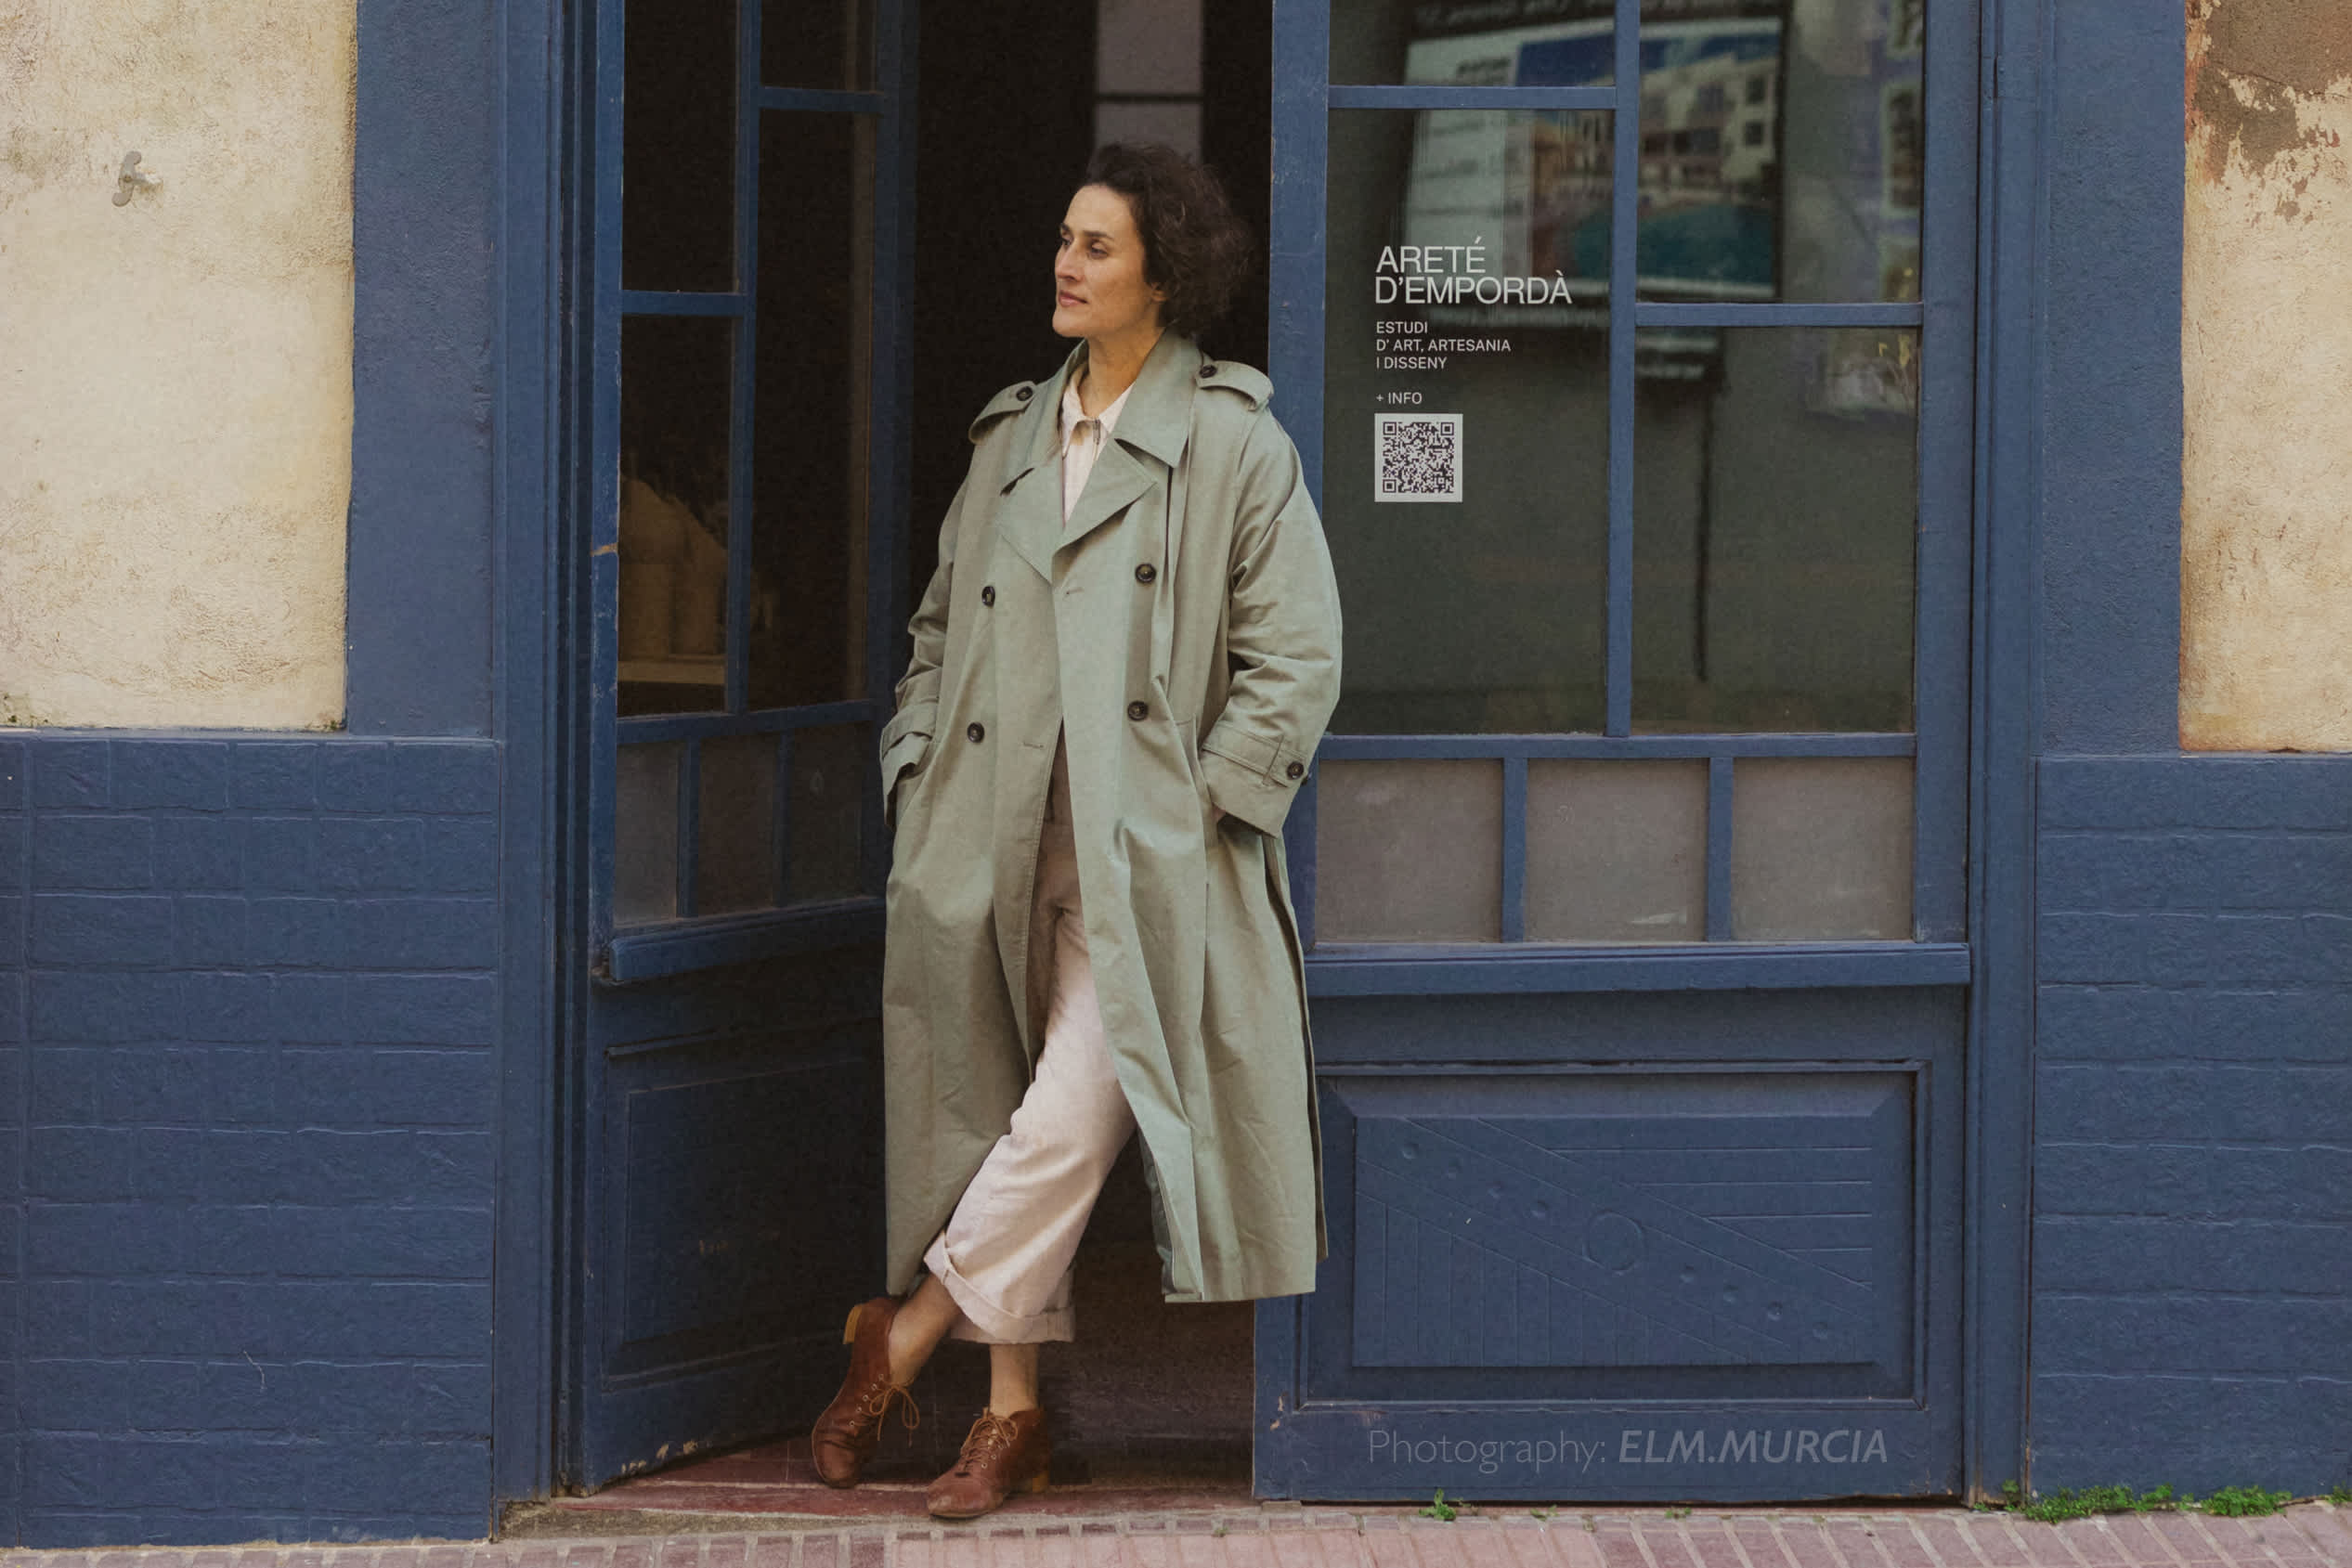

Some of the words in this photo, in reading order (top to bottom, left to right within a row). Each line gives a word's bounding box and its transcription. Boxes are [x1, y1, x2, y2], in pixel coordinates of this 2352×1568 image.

[1375, 236, 1486, 273] ARETÉ
[1376, 321, 1428, 334] ESTUDI
[1393, 339, 1424, 353] ART,
[1428, 339, 1512, 352] ARTESANIA
[1384, 356, 1448, 369] DISSENY
[1388, 392, 1423, 405] INFO
